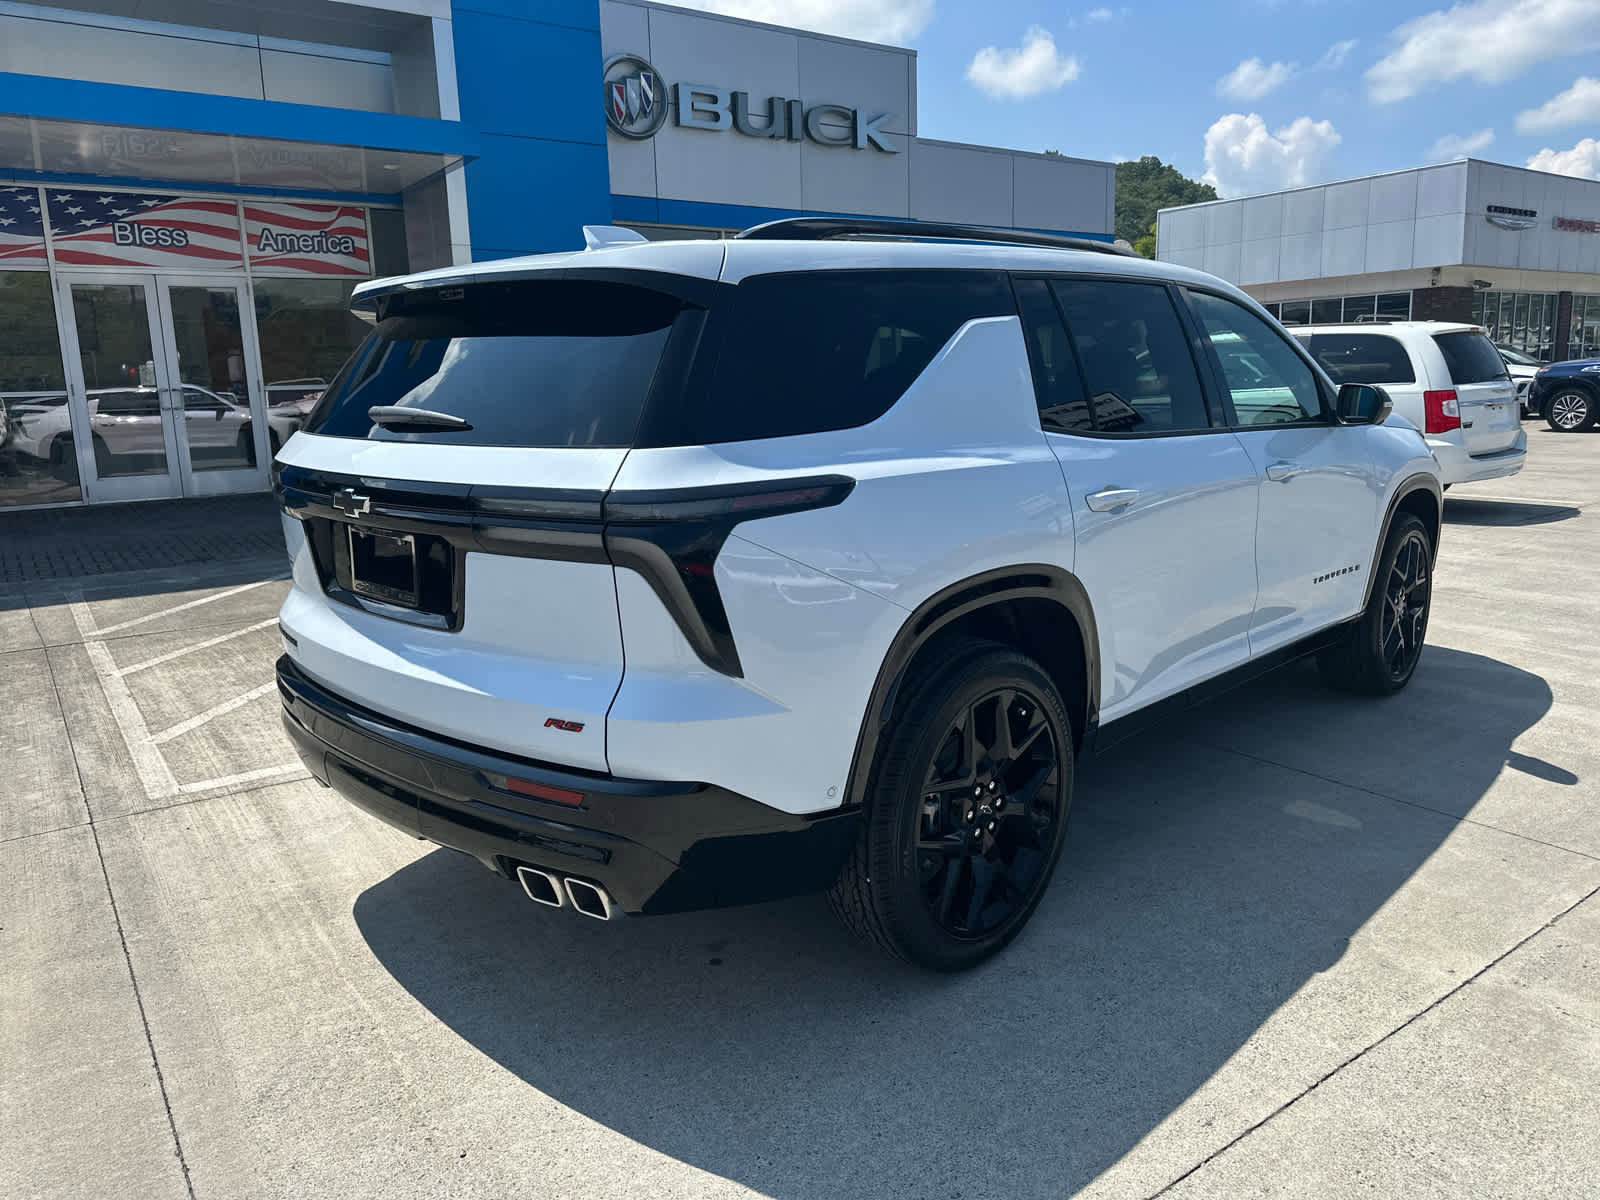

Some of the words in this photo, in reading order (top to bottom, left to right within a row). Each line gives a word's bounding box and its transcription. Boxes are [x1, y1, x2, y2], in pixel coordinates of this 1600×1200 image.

[673, 82, 899, 154] BUICK
[112, 221, 188, 247] Bless
[258, 228, 354, 254] America
[1312, 564, 1361, 585] TRAVERSE
[543, 717, 585, 733] RS
